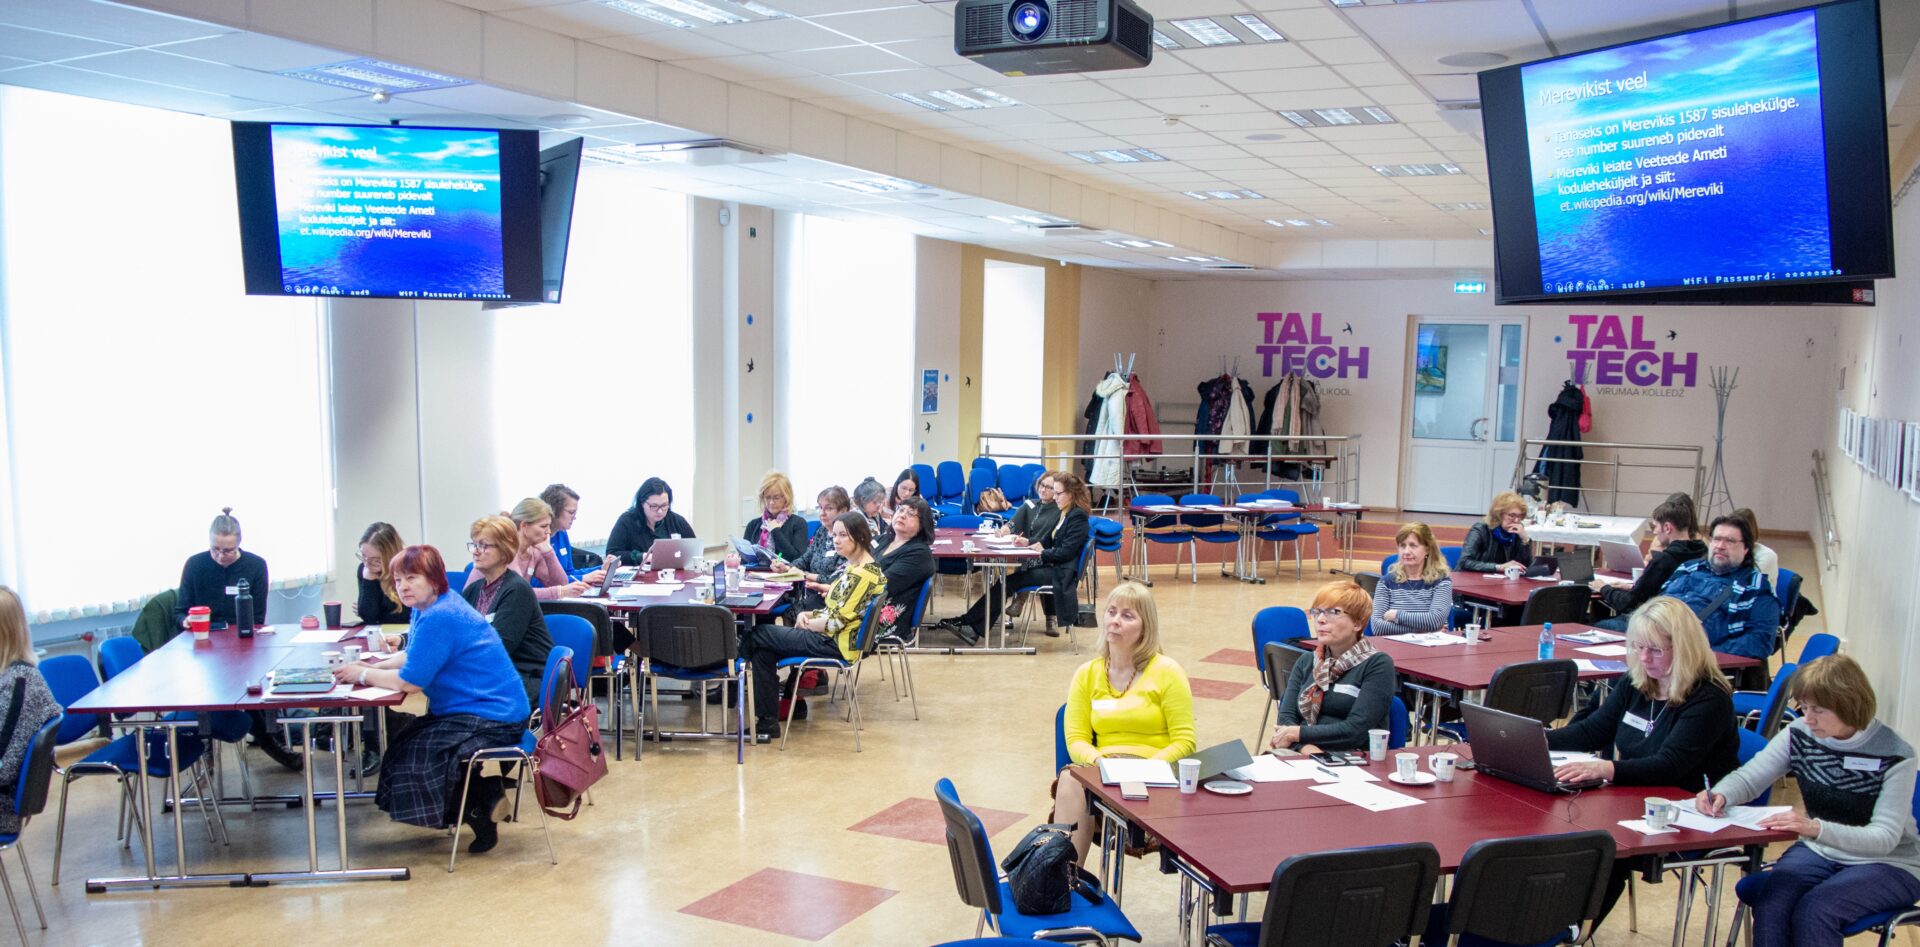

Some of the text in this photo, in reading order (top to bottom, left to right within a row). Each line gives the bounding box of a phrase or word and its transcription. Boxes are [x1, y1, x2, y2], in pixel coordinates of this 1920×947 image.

[1540, 71, 1648, 105] Merevikist veel
[1605, 124, 1620, 135] on
[1622, 115, 1676, 133] Merevikis
[1679, 107, 1708, 125] 1587
[1711, 97, 1800, 120] sisulehekülge.
[351, 146, 377, 159] veel
[1554, 123, 1725, 160] See number suureneb pidevalt
[1555, 146, 1728, 180] Mereviki leiate Veeteede Ameti
[317, 188, 352, 199] number
[354, 189, 396, 200] suureneb
[398, 191, 434, 202] pidevalt
[341, 178, 353, 187] on
[400, 179, 422, 189] 1587
[1557, 171, 1677, 197] koduleheküljelt ja siit:
[1560, 182, 1724, 212] et.wikipedia.org/wiki/Mereviki
[368, 216, 378, 227] ja
[408, 205, 435, 216] Ameti
[300, 227, 432, 239] et.wikipedia.org/wiki/Mereviki
[1621, 280, 1646, 289] aud9
[1683, 275, 1709, 285] WiFi
[1716, 271, 1777, 284] Password:
[1257, 312, 1333, 345] TAL
[1568, 314, 1656, 350] TAL
[1255, 345, 1370, 379] TECH
[1566, 350, 1699, 388] TECH
[1596, 387, 1640, 396] VIRUMAA
